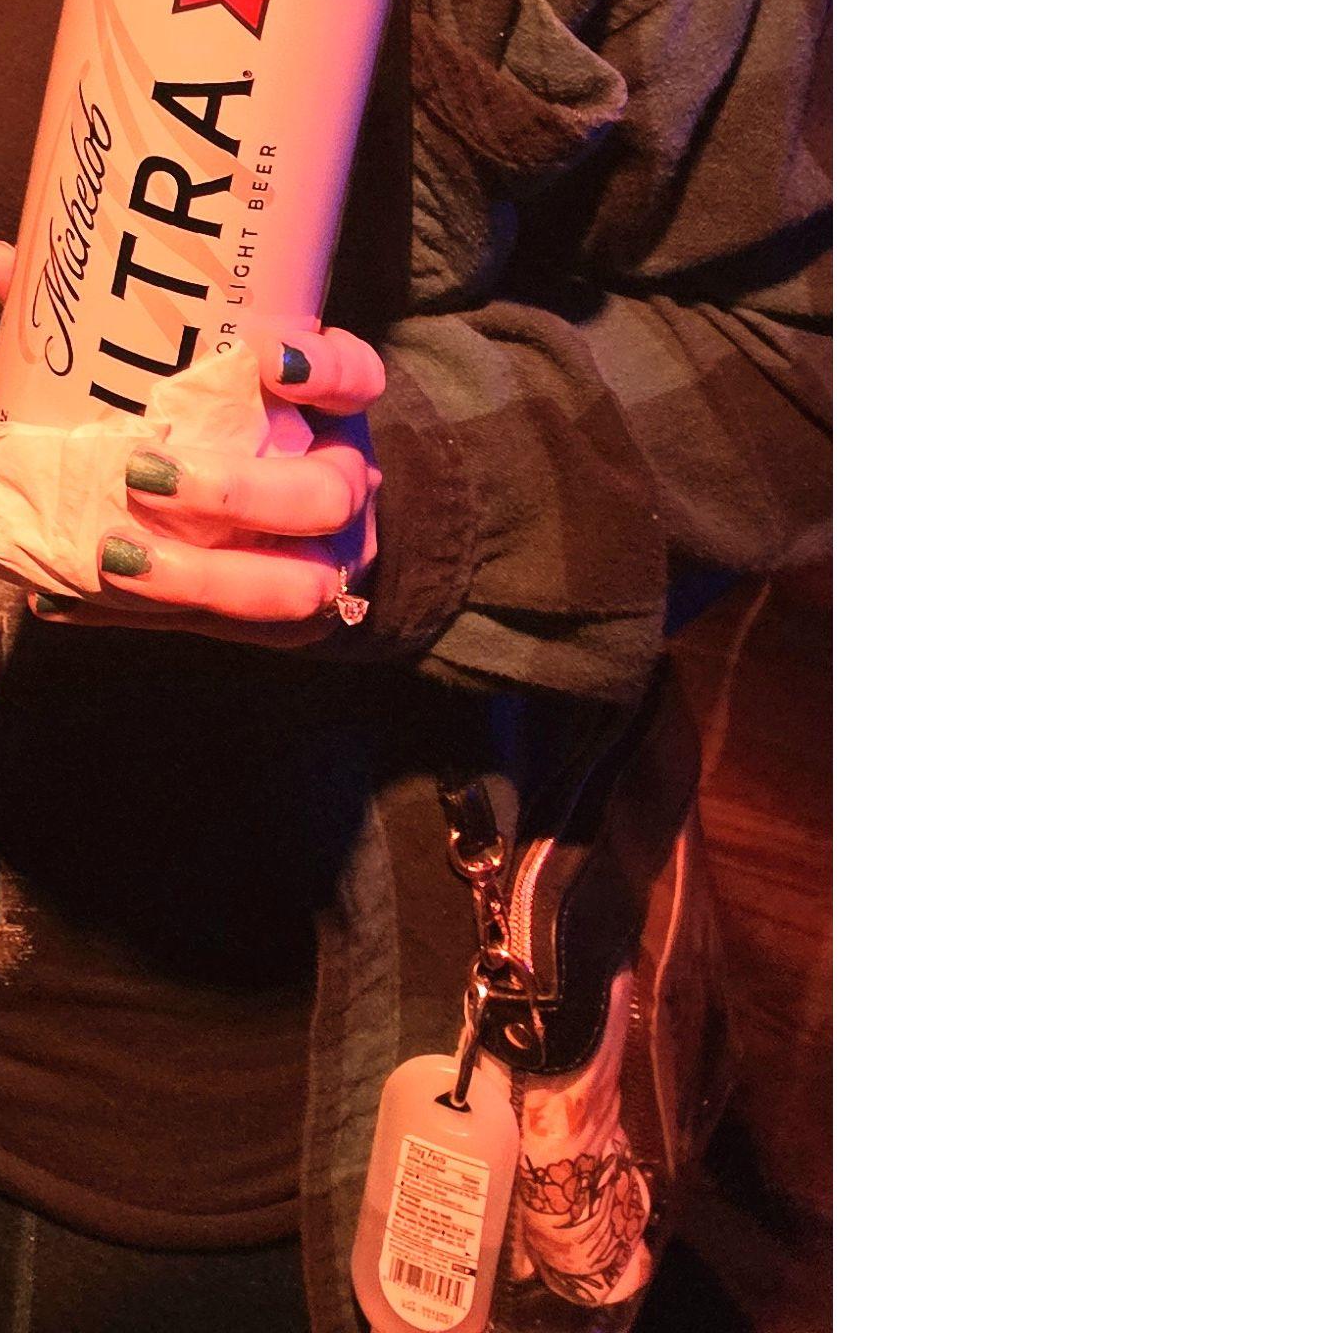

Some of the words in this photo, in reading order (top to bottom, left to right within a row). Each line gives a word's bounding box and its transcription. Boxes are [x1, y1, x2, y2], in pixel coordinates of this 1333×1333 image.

[32, 79, 112, 377] Michelob
[226, 227, 259, 305] LIGHT
[247, 144, 277, 211] BEER
